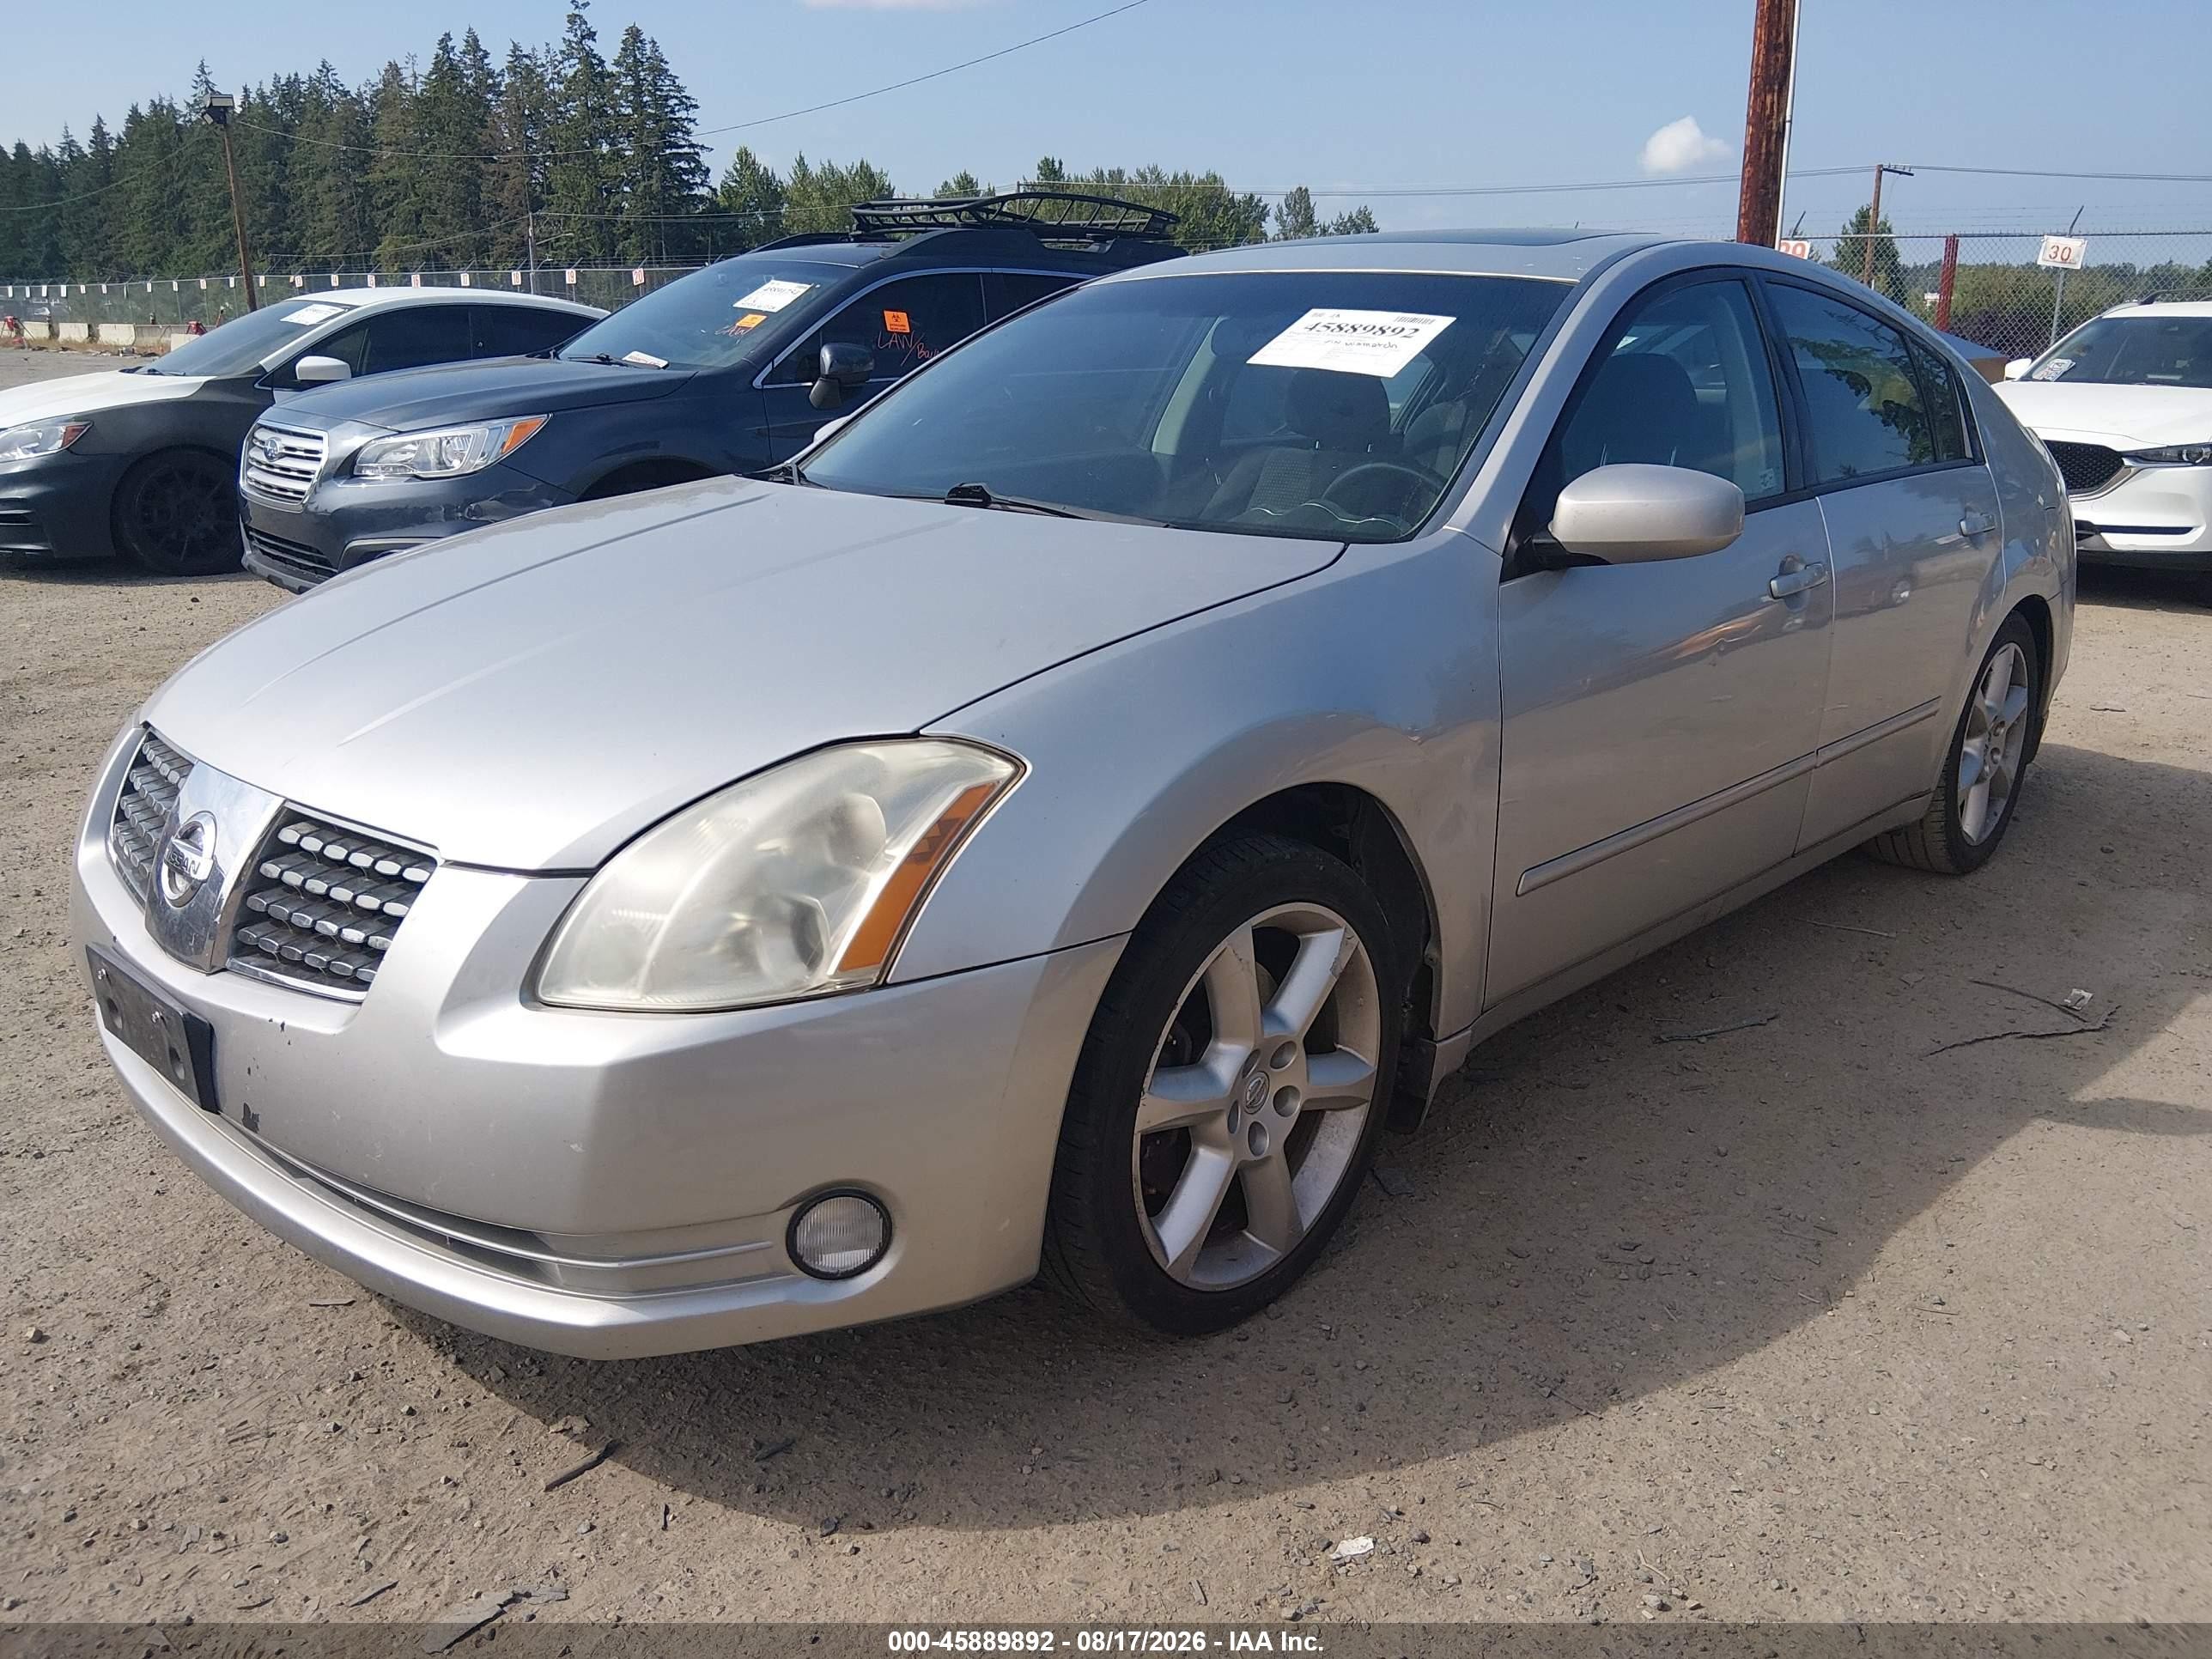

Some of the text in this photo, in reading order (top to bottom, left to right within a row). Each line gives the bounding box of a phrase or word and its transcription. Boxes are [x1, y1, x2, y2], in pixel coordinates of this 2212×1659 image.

[2048, 244, 2072, 262] 30
[635, 270, 643, 284] 20
[1304, 321, 1420, 338] 45889892
